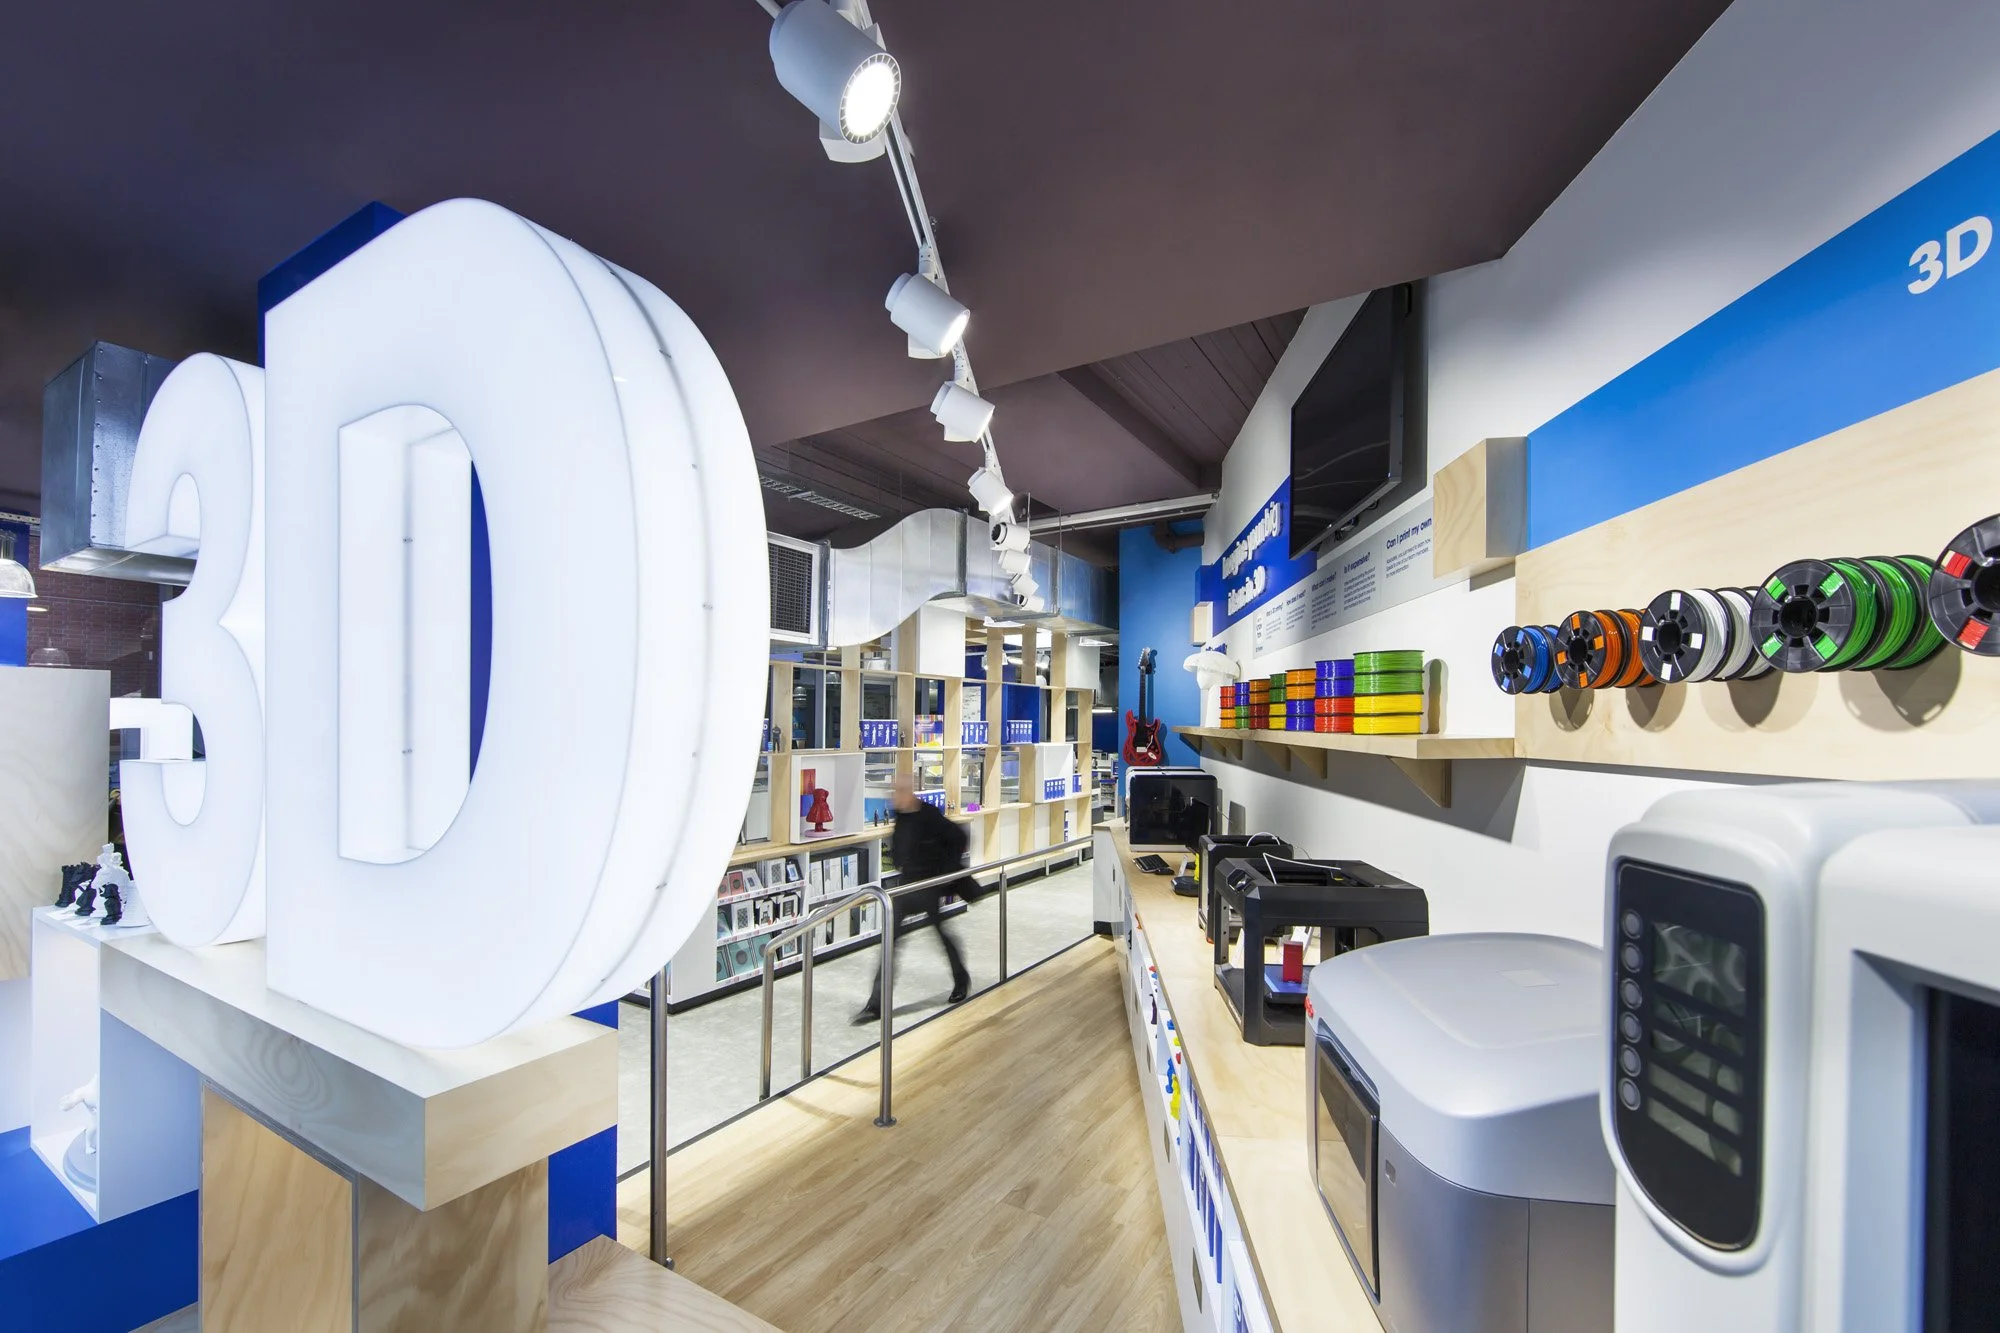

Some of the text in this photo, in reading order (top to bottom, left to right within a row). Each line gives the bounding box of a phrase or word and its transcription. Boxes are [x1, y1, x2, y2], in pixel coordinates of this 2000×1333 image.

[1907, 215, 1993, 295] 3D
[1386, 538, 1397, 550] Can
[1400, 528, 1411, 544] print
[1411, 525, 1419, 536] my
[1420, 517, 1432, 531] own
[120, 198, 771, 1050] 3D
